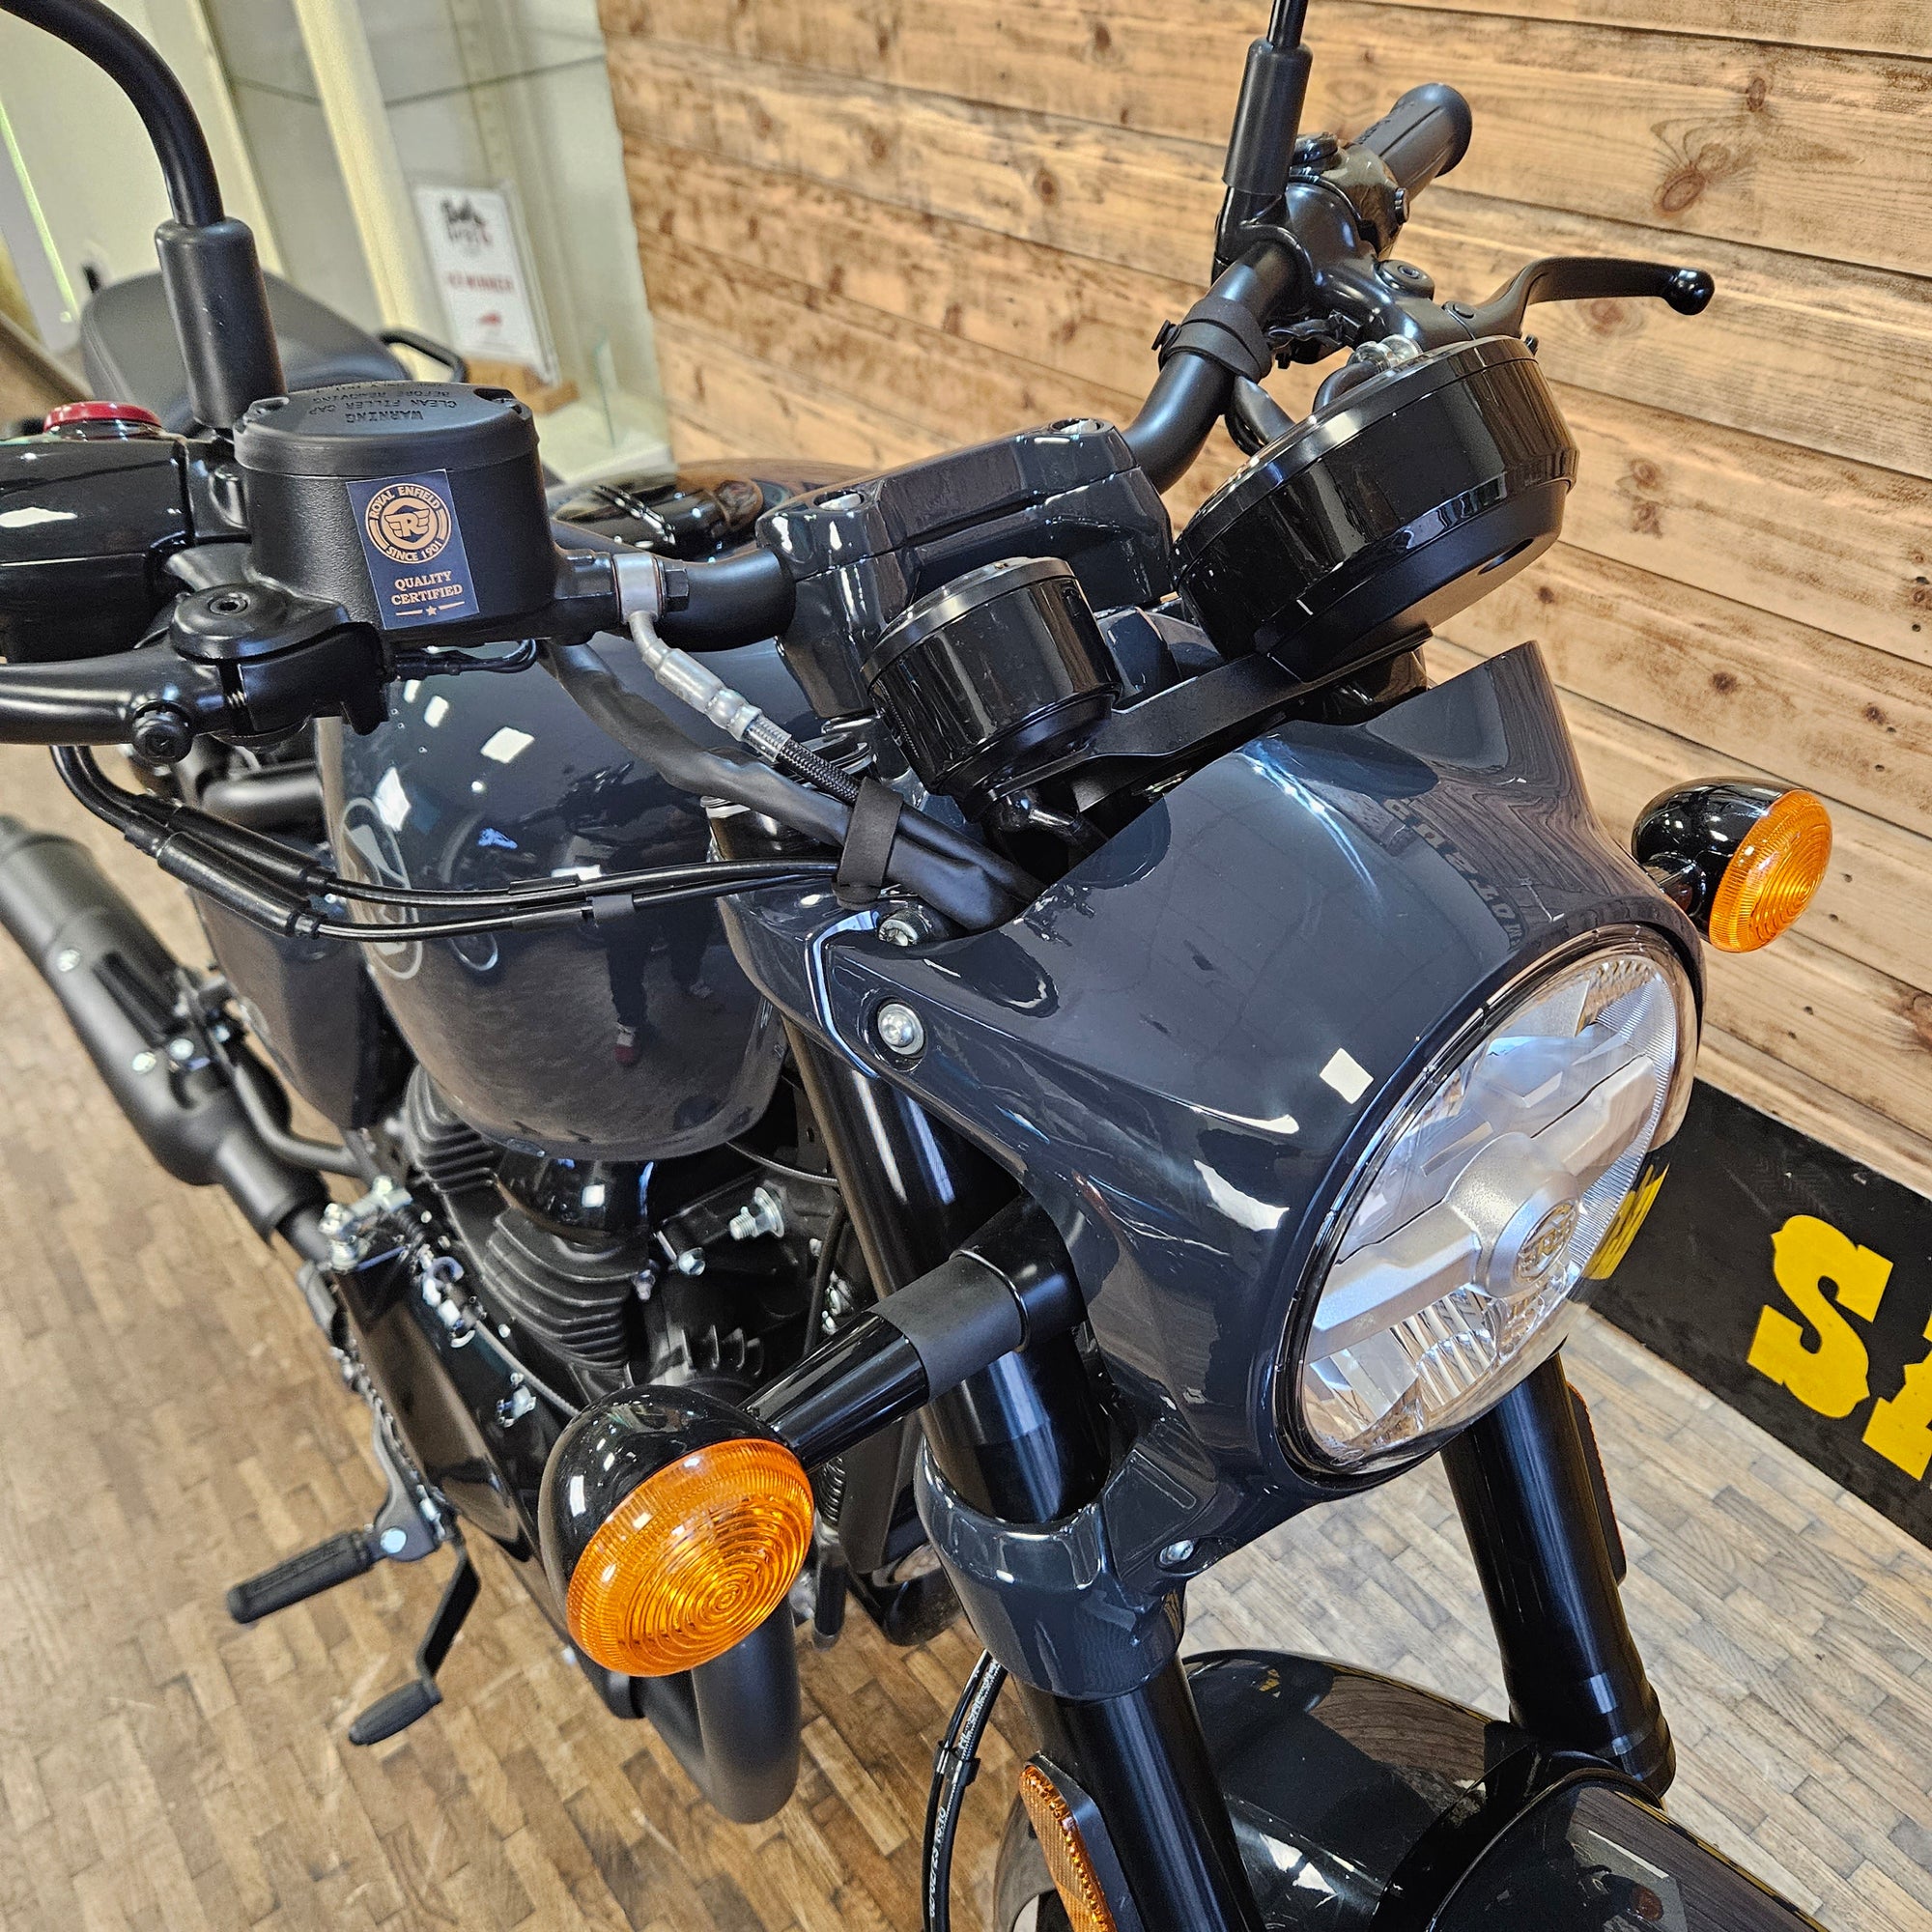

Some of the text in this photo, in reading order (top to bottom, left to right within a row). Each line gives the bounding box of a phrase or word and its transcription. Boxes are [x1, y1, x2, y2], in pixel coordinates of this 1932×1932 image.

[309, 399, 458, 415] CLEAN FILLER CAP
[345, 410, 424, 424] WARNING
[369, 486, 441, 520] ROYAL ENFIELD
[386, 540, 443, 562] SINCE 1901
[394, 570, 452, 592] QUALITY
[390, 583, 464, 606] CERTIFIED
